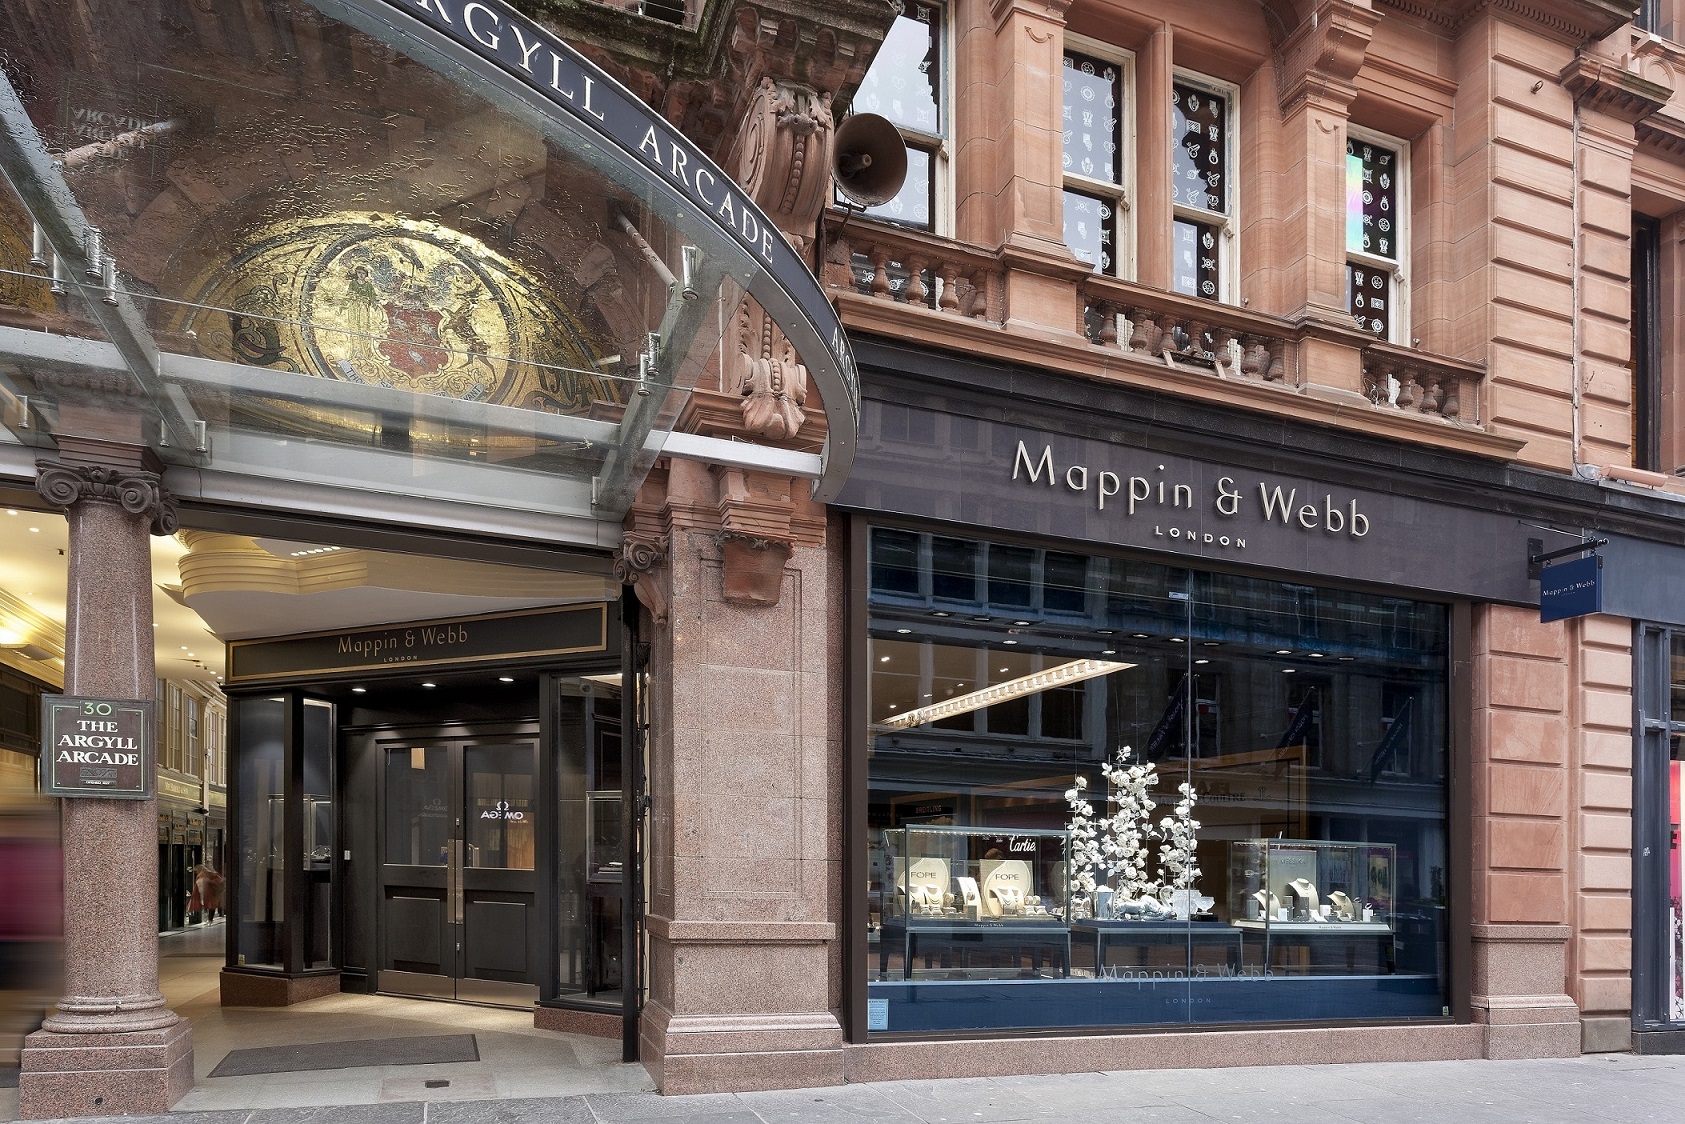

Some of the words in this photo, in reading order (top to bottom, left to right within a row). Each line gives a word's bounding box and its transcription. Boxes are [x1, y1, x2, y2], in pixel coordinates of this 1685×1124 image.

[639, 125, 774, 264] ARCADE
[1011, 439, 1192, 515] Mappin
[1216, 476, 1243, 515] &
[1260, 481, 1370, 537] Webb
[1155, 525, 1247, 549] LONDON
[1542, 587, 1568, 597] Mappin
[1576, 579, 1596, 589] Webb
[338, 632, 397, 657] Mappin
[405, 630, 416, 648] &
[421, 624, 468, 646] Webb
[383, 655, 418, 663] LONDON
[83, 701, 112, 716] 30
[76, 720, 119, 733] THE
[57, 734, 138, 750] ARGYLL
[55, 750, 139, 766] ARCADE
[915, 804, 942, 814] BREITLING
[1009, 834, 1036, 852] Cartie
[910, 871, 937, 880] FOPE
[995, 873, 1020, 881] FOPE
[1098, 962, 1184, 991] Mappin
[1195, 963, 1209, 983] &
[1216, 962, 1275, 983] Webb
